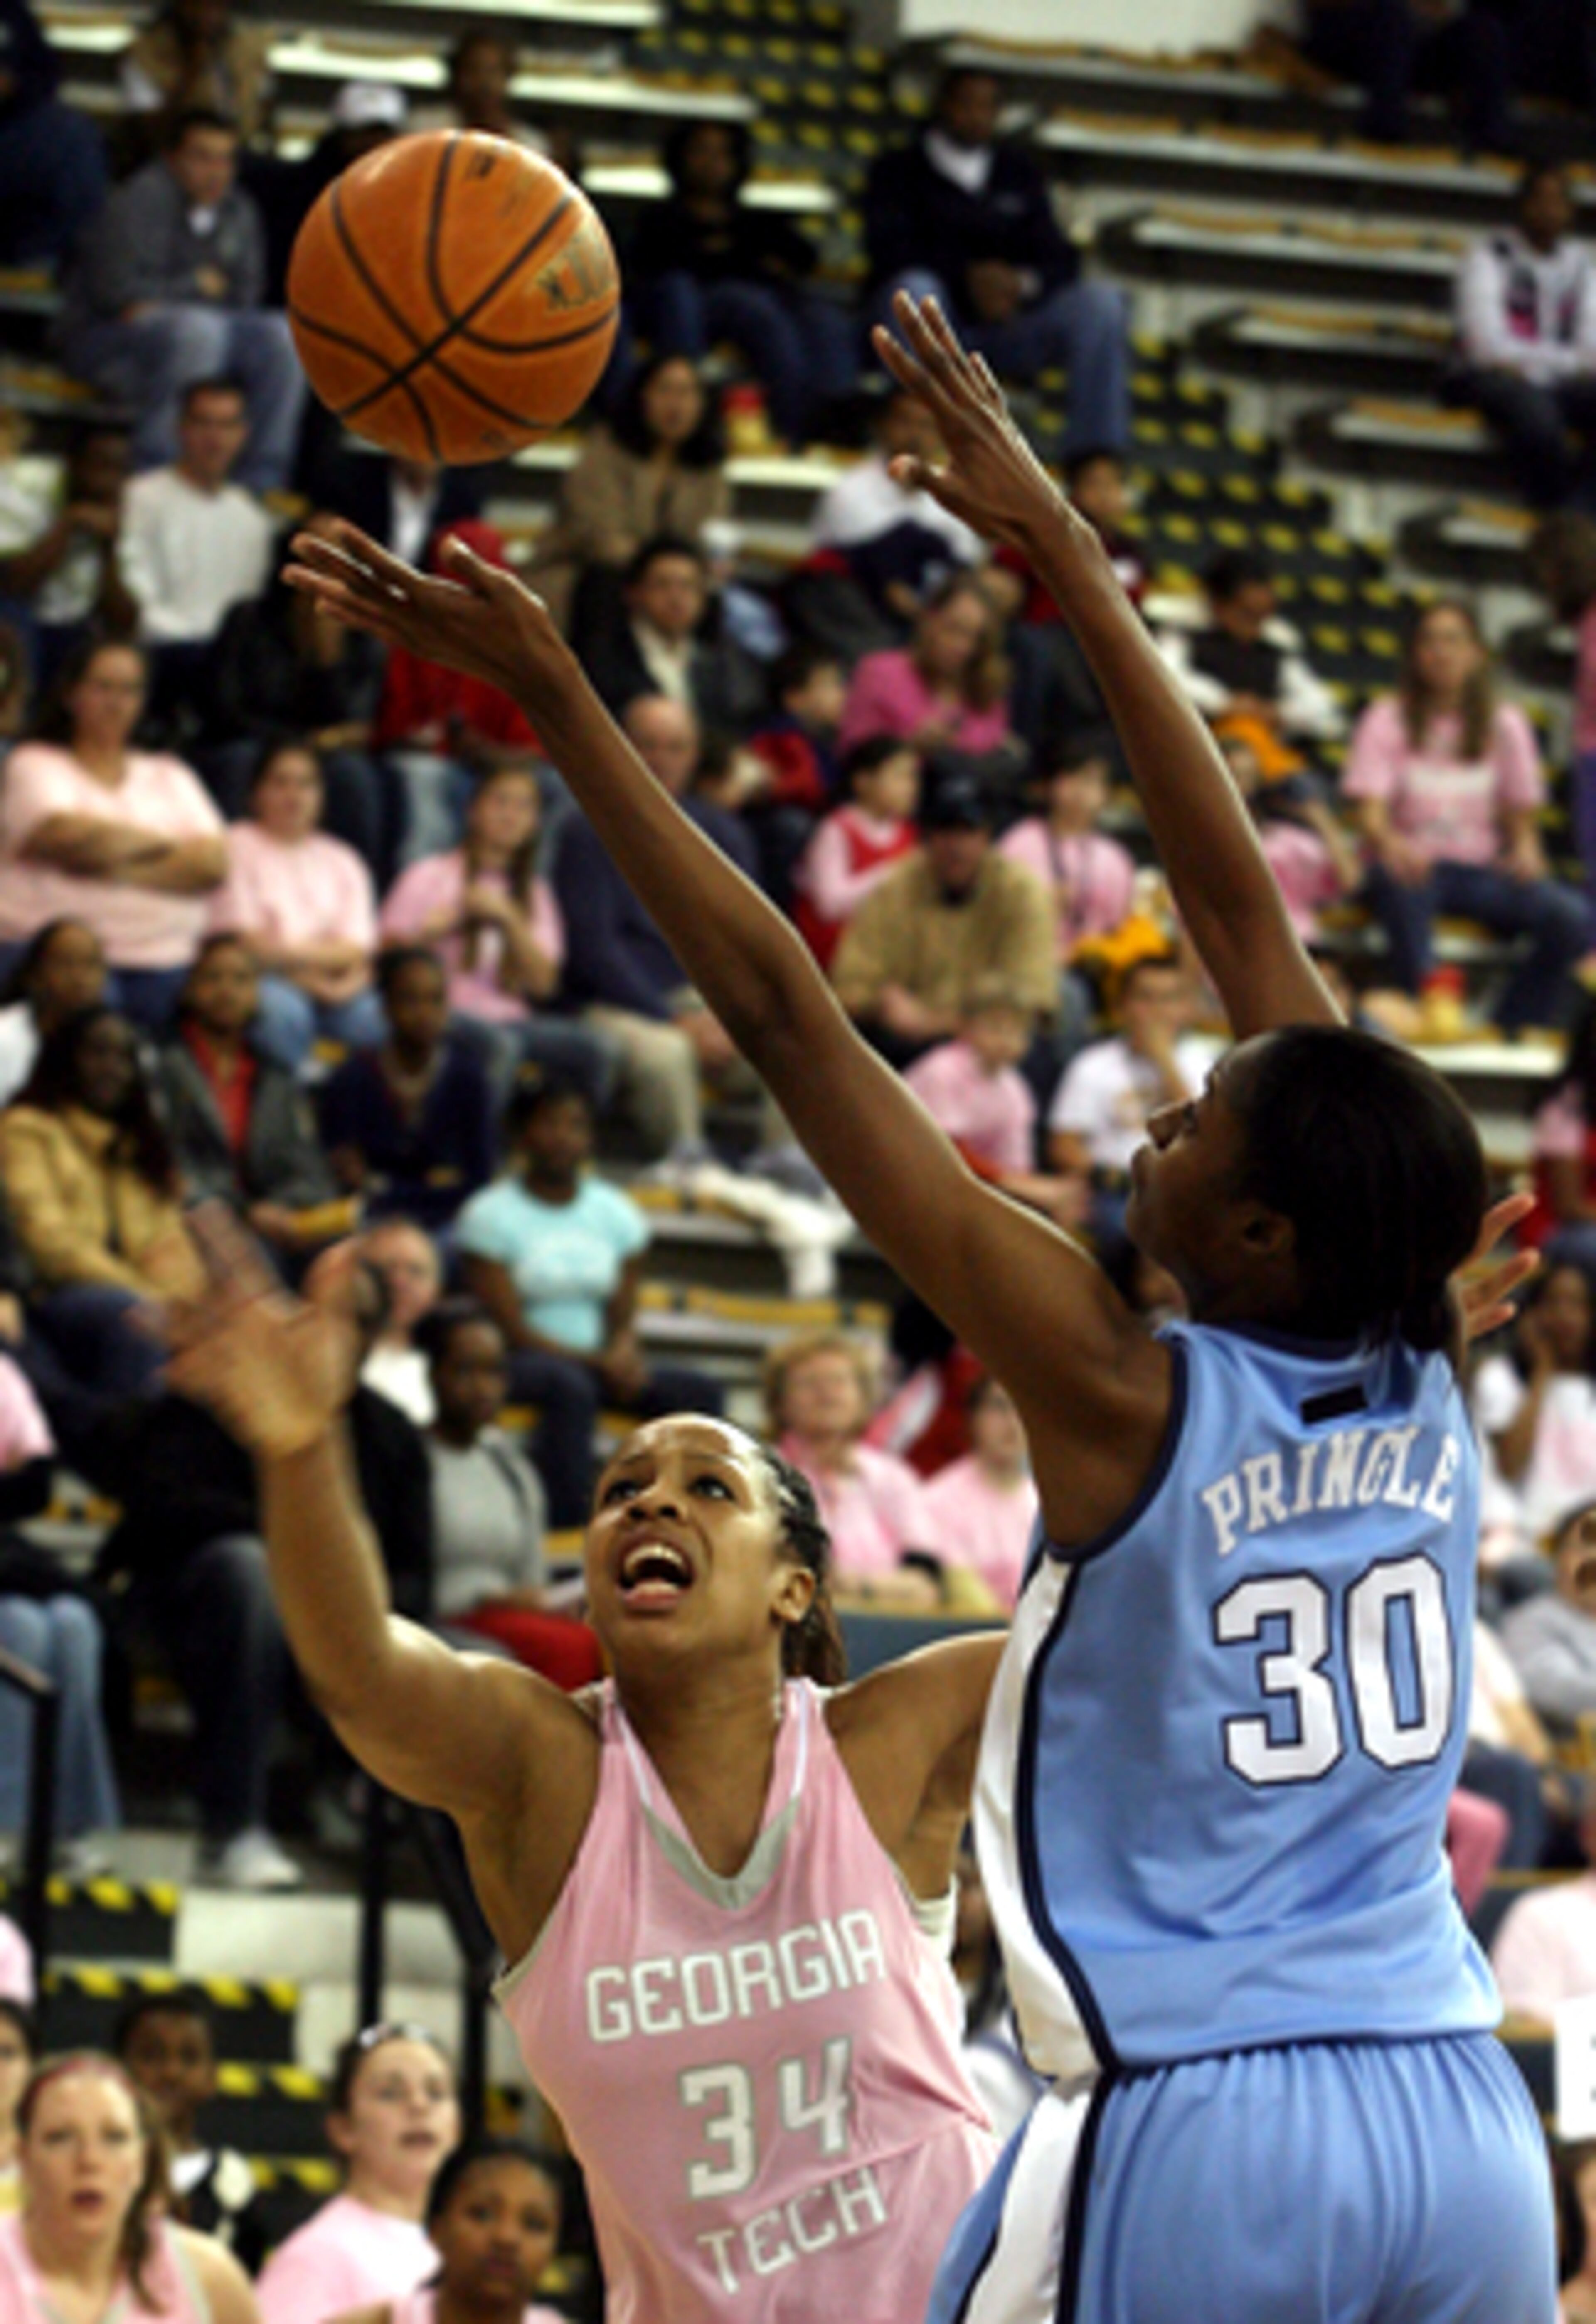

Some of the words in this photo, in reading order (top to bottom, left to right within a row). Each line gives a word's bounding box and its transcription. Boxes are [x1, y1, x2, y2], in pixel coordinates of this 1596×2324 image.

[1202, 1427, 1459, 1556] PRINGLE
[1213, 1552, 1456, 1787] 30
[587, 1910, 886, 2042] GEORGIA
[679, 2036, 852, 2199] 34
[697, 2166, 886, 2294] TECH
